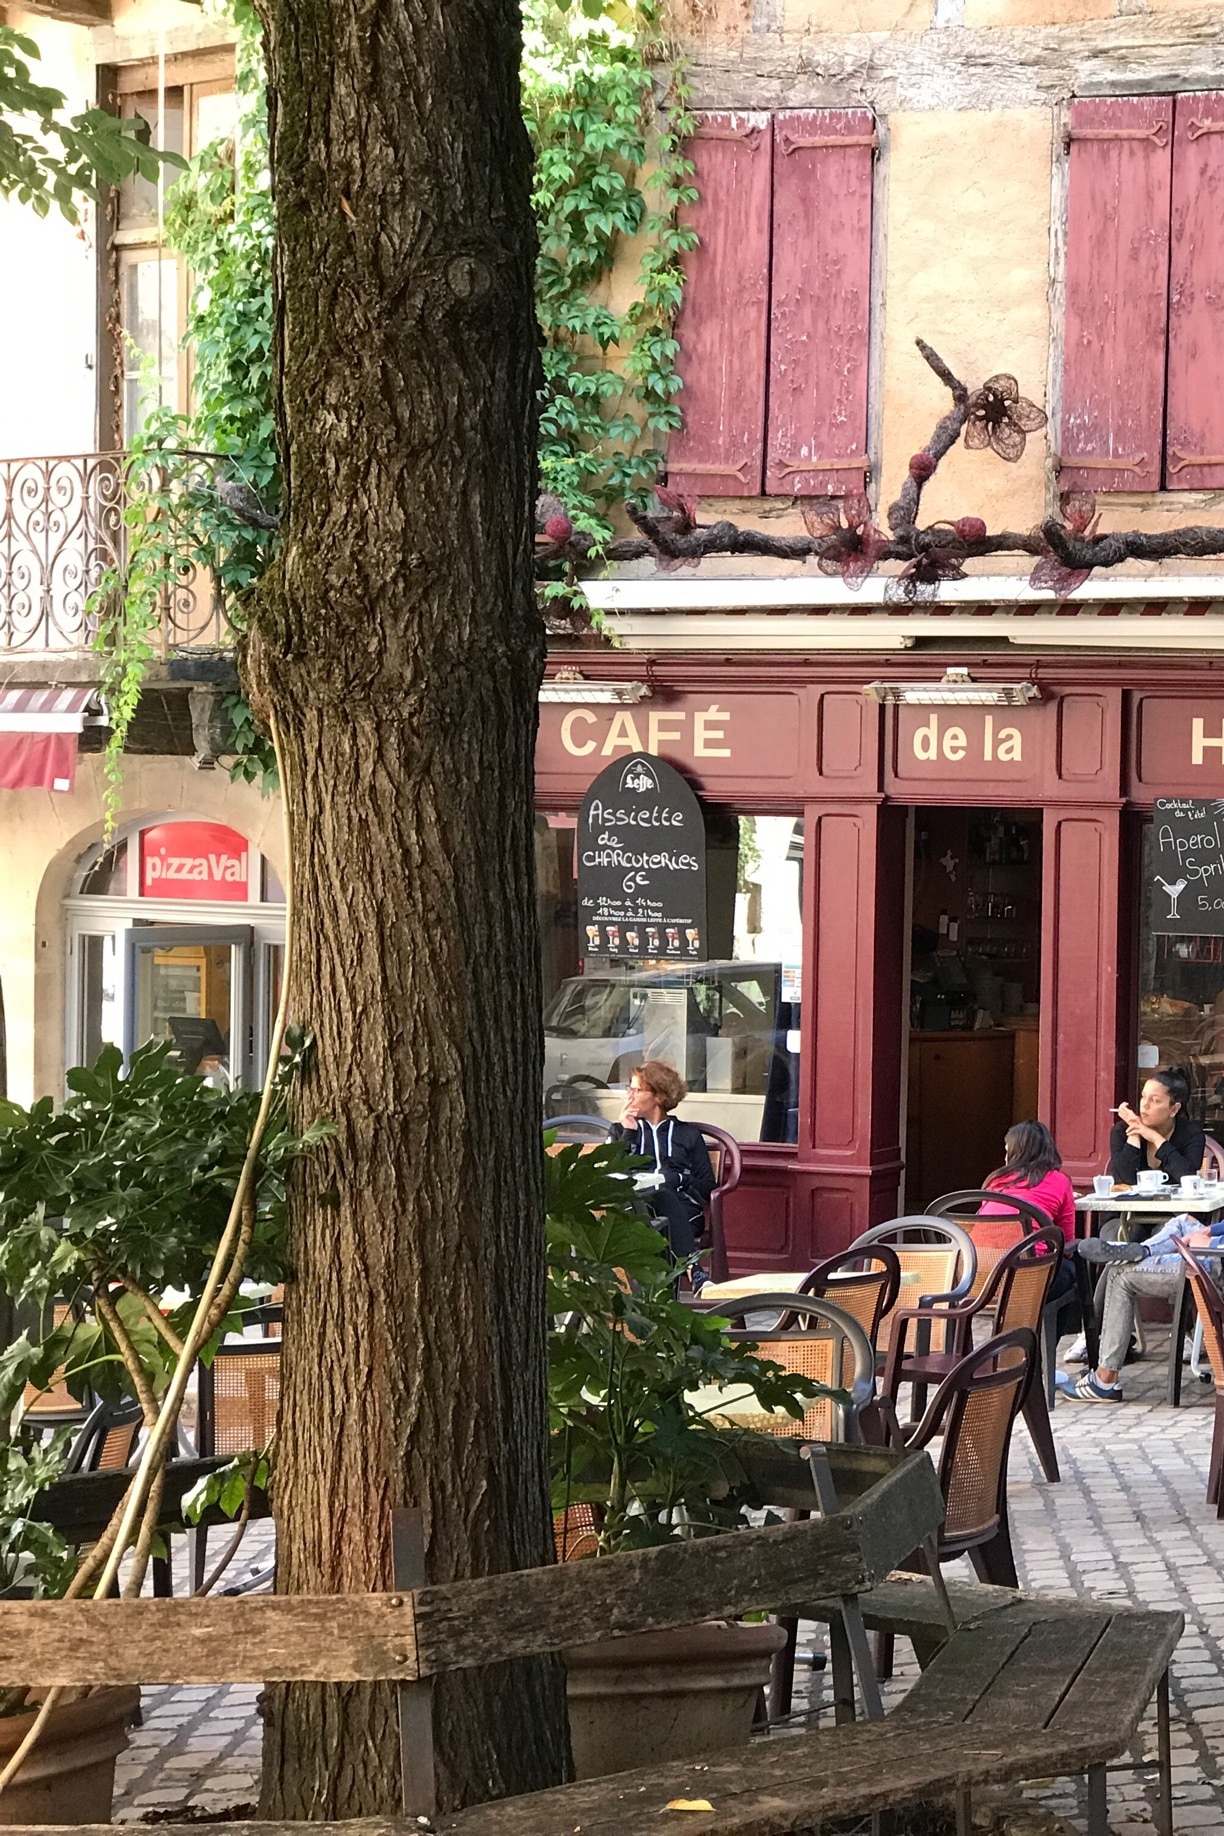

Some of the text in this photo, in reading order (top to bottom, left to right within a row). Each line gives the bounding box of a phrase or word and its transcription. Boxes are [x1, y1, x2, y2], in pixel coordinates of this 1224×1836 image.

[560, 704, 731, 758] CAFÉ
[913, 713, 967, 762] de
[983, 714, 1022, 762] la
[624, 773, 655, 793] Leffe
[1157, 799, 1195, 810] Cocktail
[1175, 809, 1186, 818] de
[588, 799, 684, 833] Assiette
[597, 831, 624, 848] de
[1159, 821, 1220, 867] Aperol
[145, 846, 248, 887] pizzaVal
[622, 871, 650, 893] 6€
[582, 896, 595, 907] de
[624, 897, 634, 907] à
[626, 907, 636, 917] à
